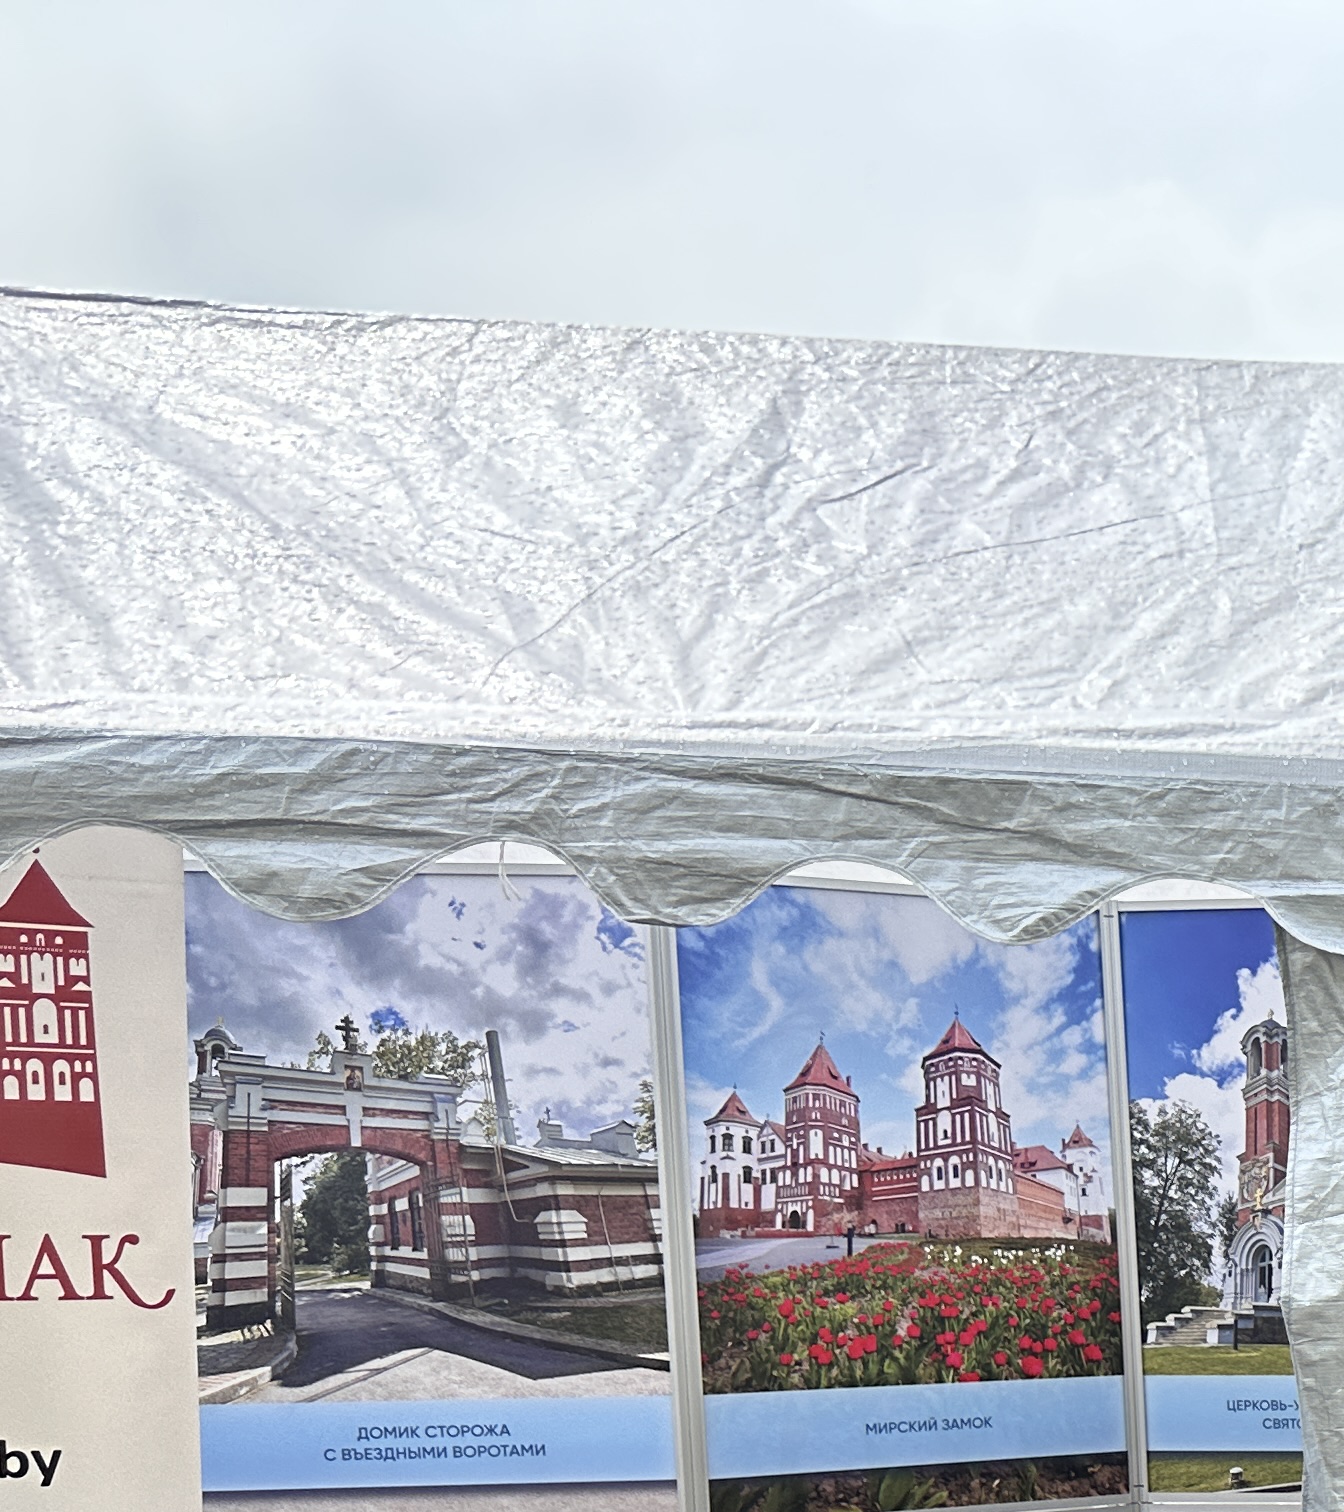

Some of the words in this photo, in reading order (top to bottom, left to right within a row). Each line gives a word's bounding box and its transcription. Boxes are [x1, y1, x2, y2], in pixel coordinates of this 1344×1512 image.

[357, 1425, 421, 1442] ДОМИК
[424, 1423, 512, 1439] СТОРОЖА
[865, 1416, 938, 1436] МИРСКИЙ
[941, 1415, 993, 1431] ЗАМОК
[323, 1448, 337, 1462] С
[341, 1445, 448, 1462] ВЪЕЗДНЫМИ
[452, 1443, 547, 1459] ВОРОТАМИ
[0, 1439, 62, 1487] by
